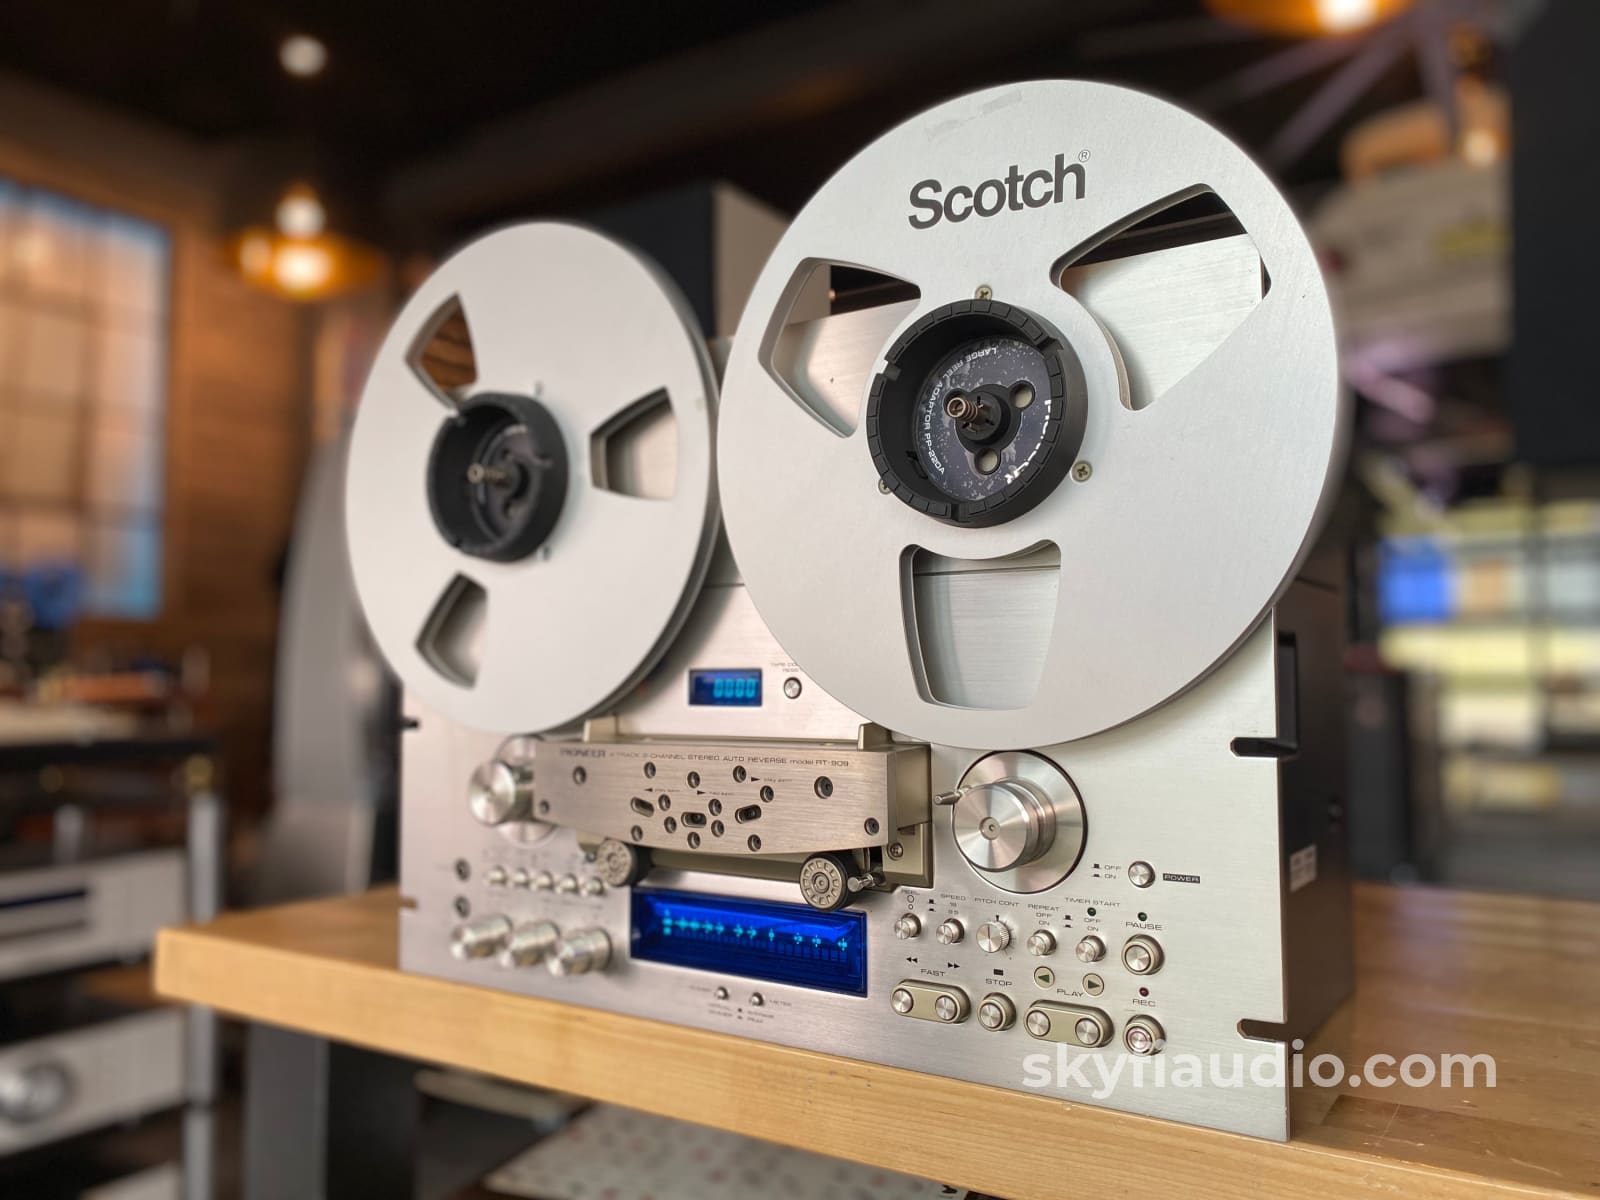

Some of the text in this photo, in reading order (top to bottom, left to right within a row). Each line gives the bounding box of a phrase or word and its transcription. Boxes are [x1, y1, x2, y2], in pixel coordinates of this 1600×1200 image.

[908, 153, 1086, 229] Scotch
[924, 346, 998, 475] LARGE REEL ADAPTOR PP-220A
[815, 759, 849, 767] RT-909
[1164, 874, 1199, 883] POWER
[941, 893, 966, 901] SPEED
[974, 897, 1020, 908] PITCH CONT
[1065, 897, 1121, 908] TIMER START
[1027, 903, 1060, 912] REPEAT
[1125, 921, 1163, 931] PAUSE
[920, 968, 946, 977] FAST
[985, 978, 1012, 987] STOP
[1056, 988, 1084, 997] PLAY
[1132, 998, 1156, 1008] REC
